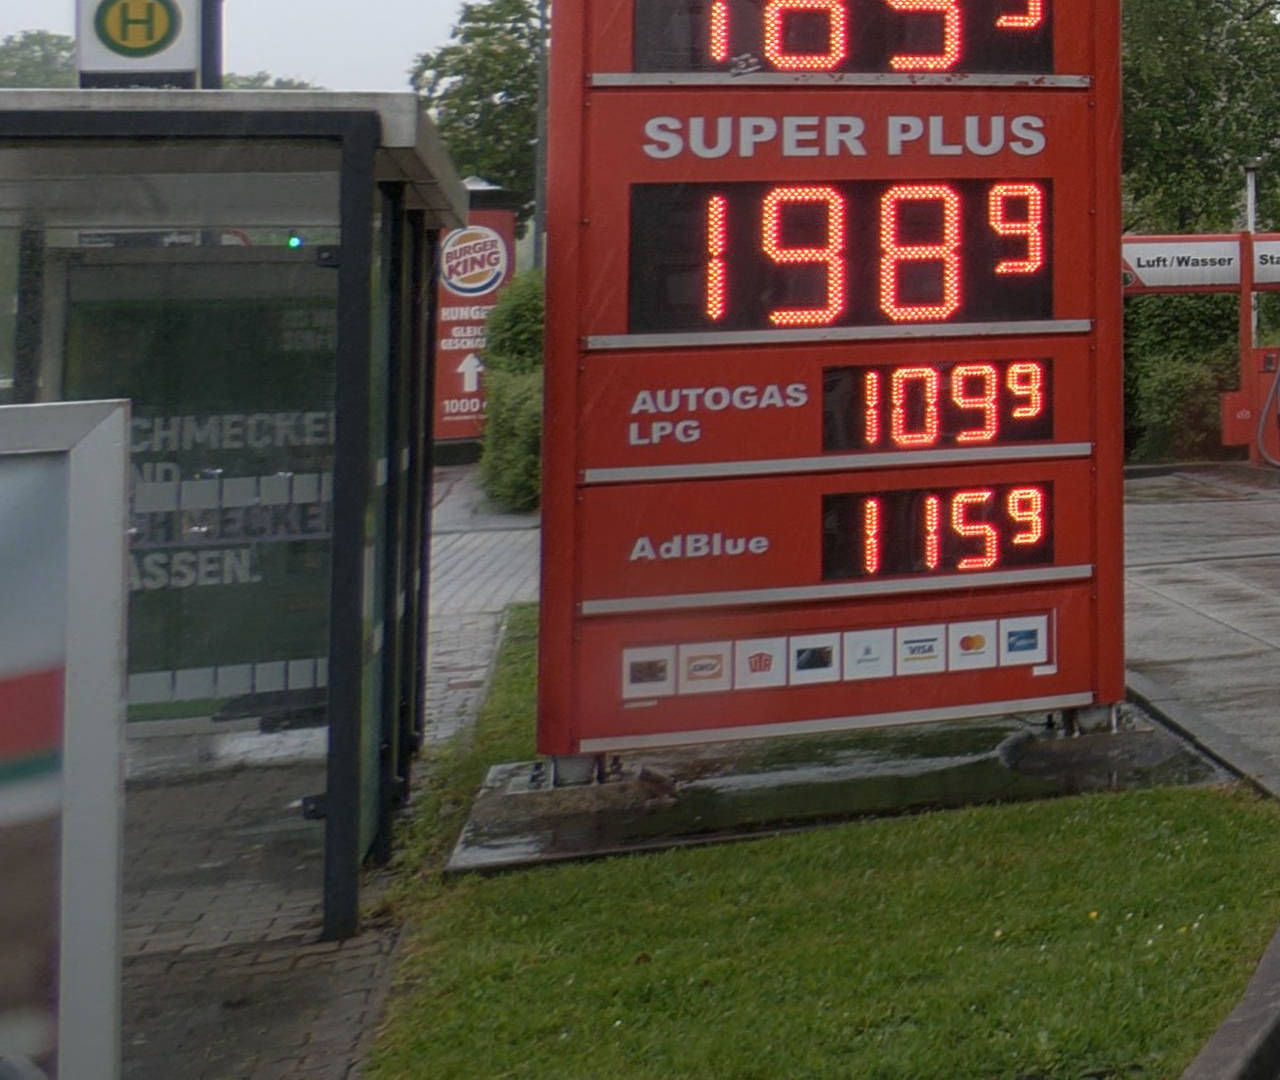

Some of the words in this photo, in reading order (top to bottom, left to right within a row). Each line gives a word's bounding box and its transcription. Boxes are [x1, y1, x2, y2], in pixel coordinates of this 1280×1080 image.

[120, 2, 154, 41] H
[642, 115, 867, 160] SUPER
[887, 115, 1047, 157] PLUS
[446, 239, 498, 265] BURGER
[447, 251, 500, 280] KING
[443, 398, 481, 414] 1000
[631, 382, 809, 415] AUTOGAS
[629, 420, 702, 447] LPG
[629, 533, 770, 562] AdBlue
[909, 644, 934, 656] VISA
